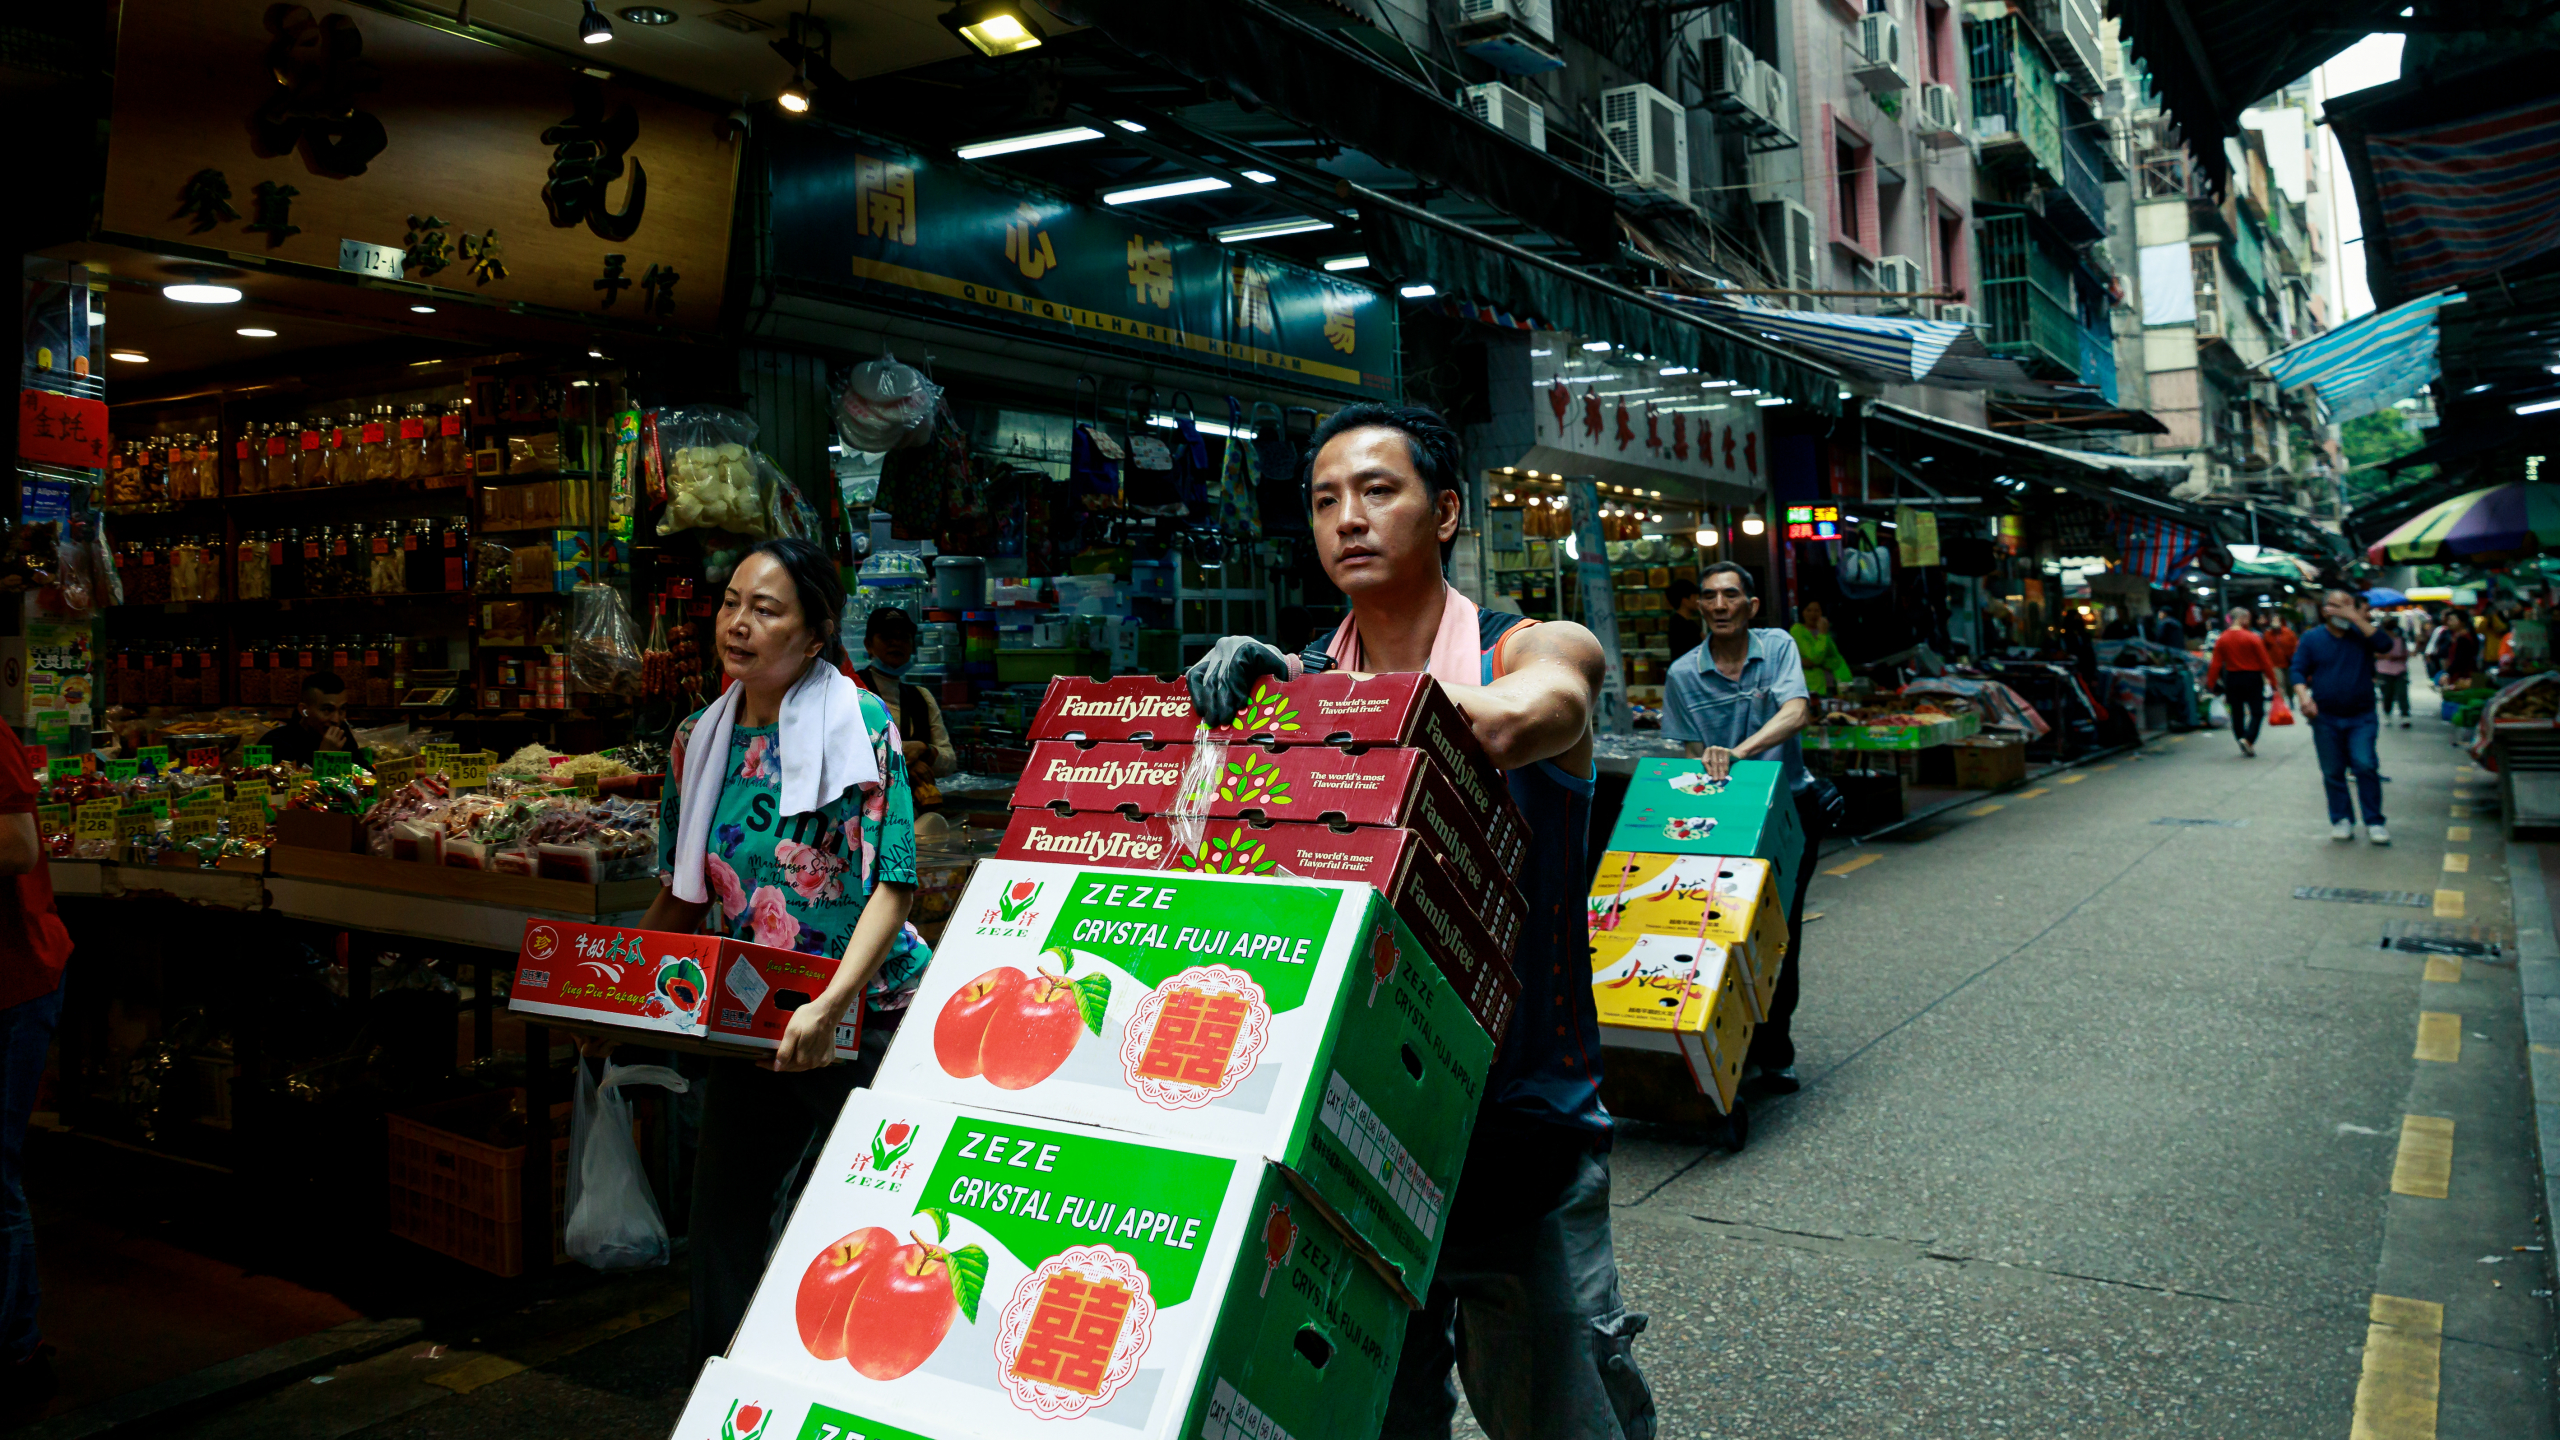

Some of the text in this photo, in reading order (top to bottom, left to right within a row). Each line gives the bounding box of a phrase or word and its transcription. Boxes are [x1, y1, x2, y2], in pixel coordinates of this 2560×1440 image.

[364, 250, 396, 274] 12-A
[593, 253, 681, 318] 手信
[963, 284, 1302, 369] QUINQUILHARIA HOI SAM
[1058, 695, 1192, 723] FamilyTree
[1320, 706, 1358, 715] flavorful
[463, 767, 477, 779] 50
[1043, 759, 1178, 790] FamilyTree
[1425, 711, 1489, 814] FamilyTree
[388, 771, 408, 785] 50
[1311, 772, 1326, 780] The
[1328, 773, 1361, 781] world's
[1313, 781, 1353, 789] flavorful
[579, 787, 594, 797] 20
[87, 820, 107, 831] 28
[239, 823, 258, 835] 28
[1136, 834, 1163, 842] FARMS
[1022, 827, 1163, 861] FamilyTree
[1420, 789, 1482, 890] FamilyTree
[1297, 850, 1374, 863] The world's most
[1299, 859, 1340, 870] flavorful
[1081, 883, 1178, 910] ZEZE
[976, 927, 1028, 938] ZEZE
[1408, 871, 1475, 973] FamilyTree
[574, 931, 646, 967] 牛奶木瓜
[1072, 918, 1312, 964] CRYSTAL FUJI APPLE
[766, 960, 826, 980] Jing Pin Papaya
[559, 980, 646, 1005] Jing Pin Papaya
[1402, 961, 1435, 1010] ZEZE
[1395, 988, 1477, 1100] CRYSTAL FUJI APPLE
[1326, 1090, 1344, 1116] CAT.1
[1358, 1108, 1367, 1123] 48
[1378, 1130, 1388, 1145] 64
[1388, 1142, 1396, 1157] 72
[958, 1132, 1061, 1173] ZEZE
[844, 1173, 903, 1193] ZEZE
[949, 1176, 1201, 1250] CRYSTAL FUJI APPLE
[1292, 1267, 1337, 1325] CRYSAL
[1340, 1311, 1362, 1347] FUJI
[1210, 1400, 1230, 1429] CAT.1
[1236, 1402, 1246, 1420] 36
[1247, 1413, 1258, 1430] 48
